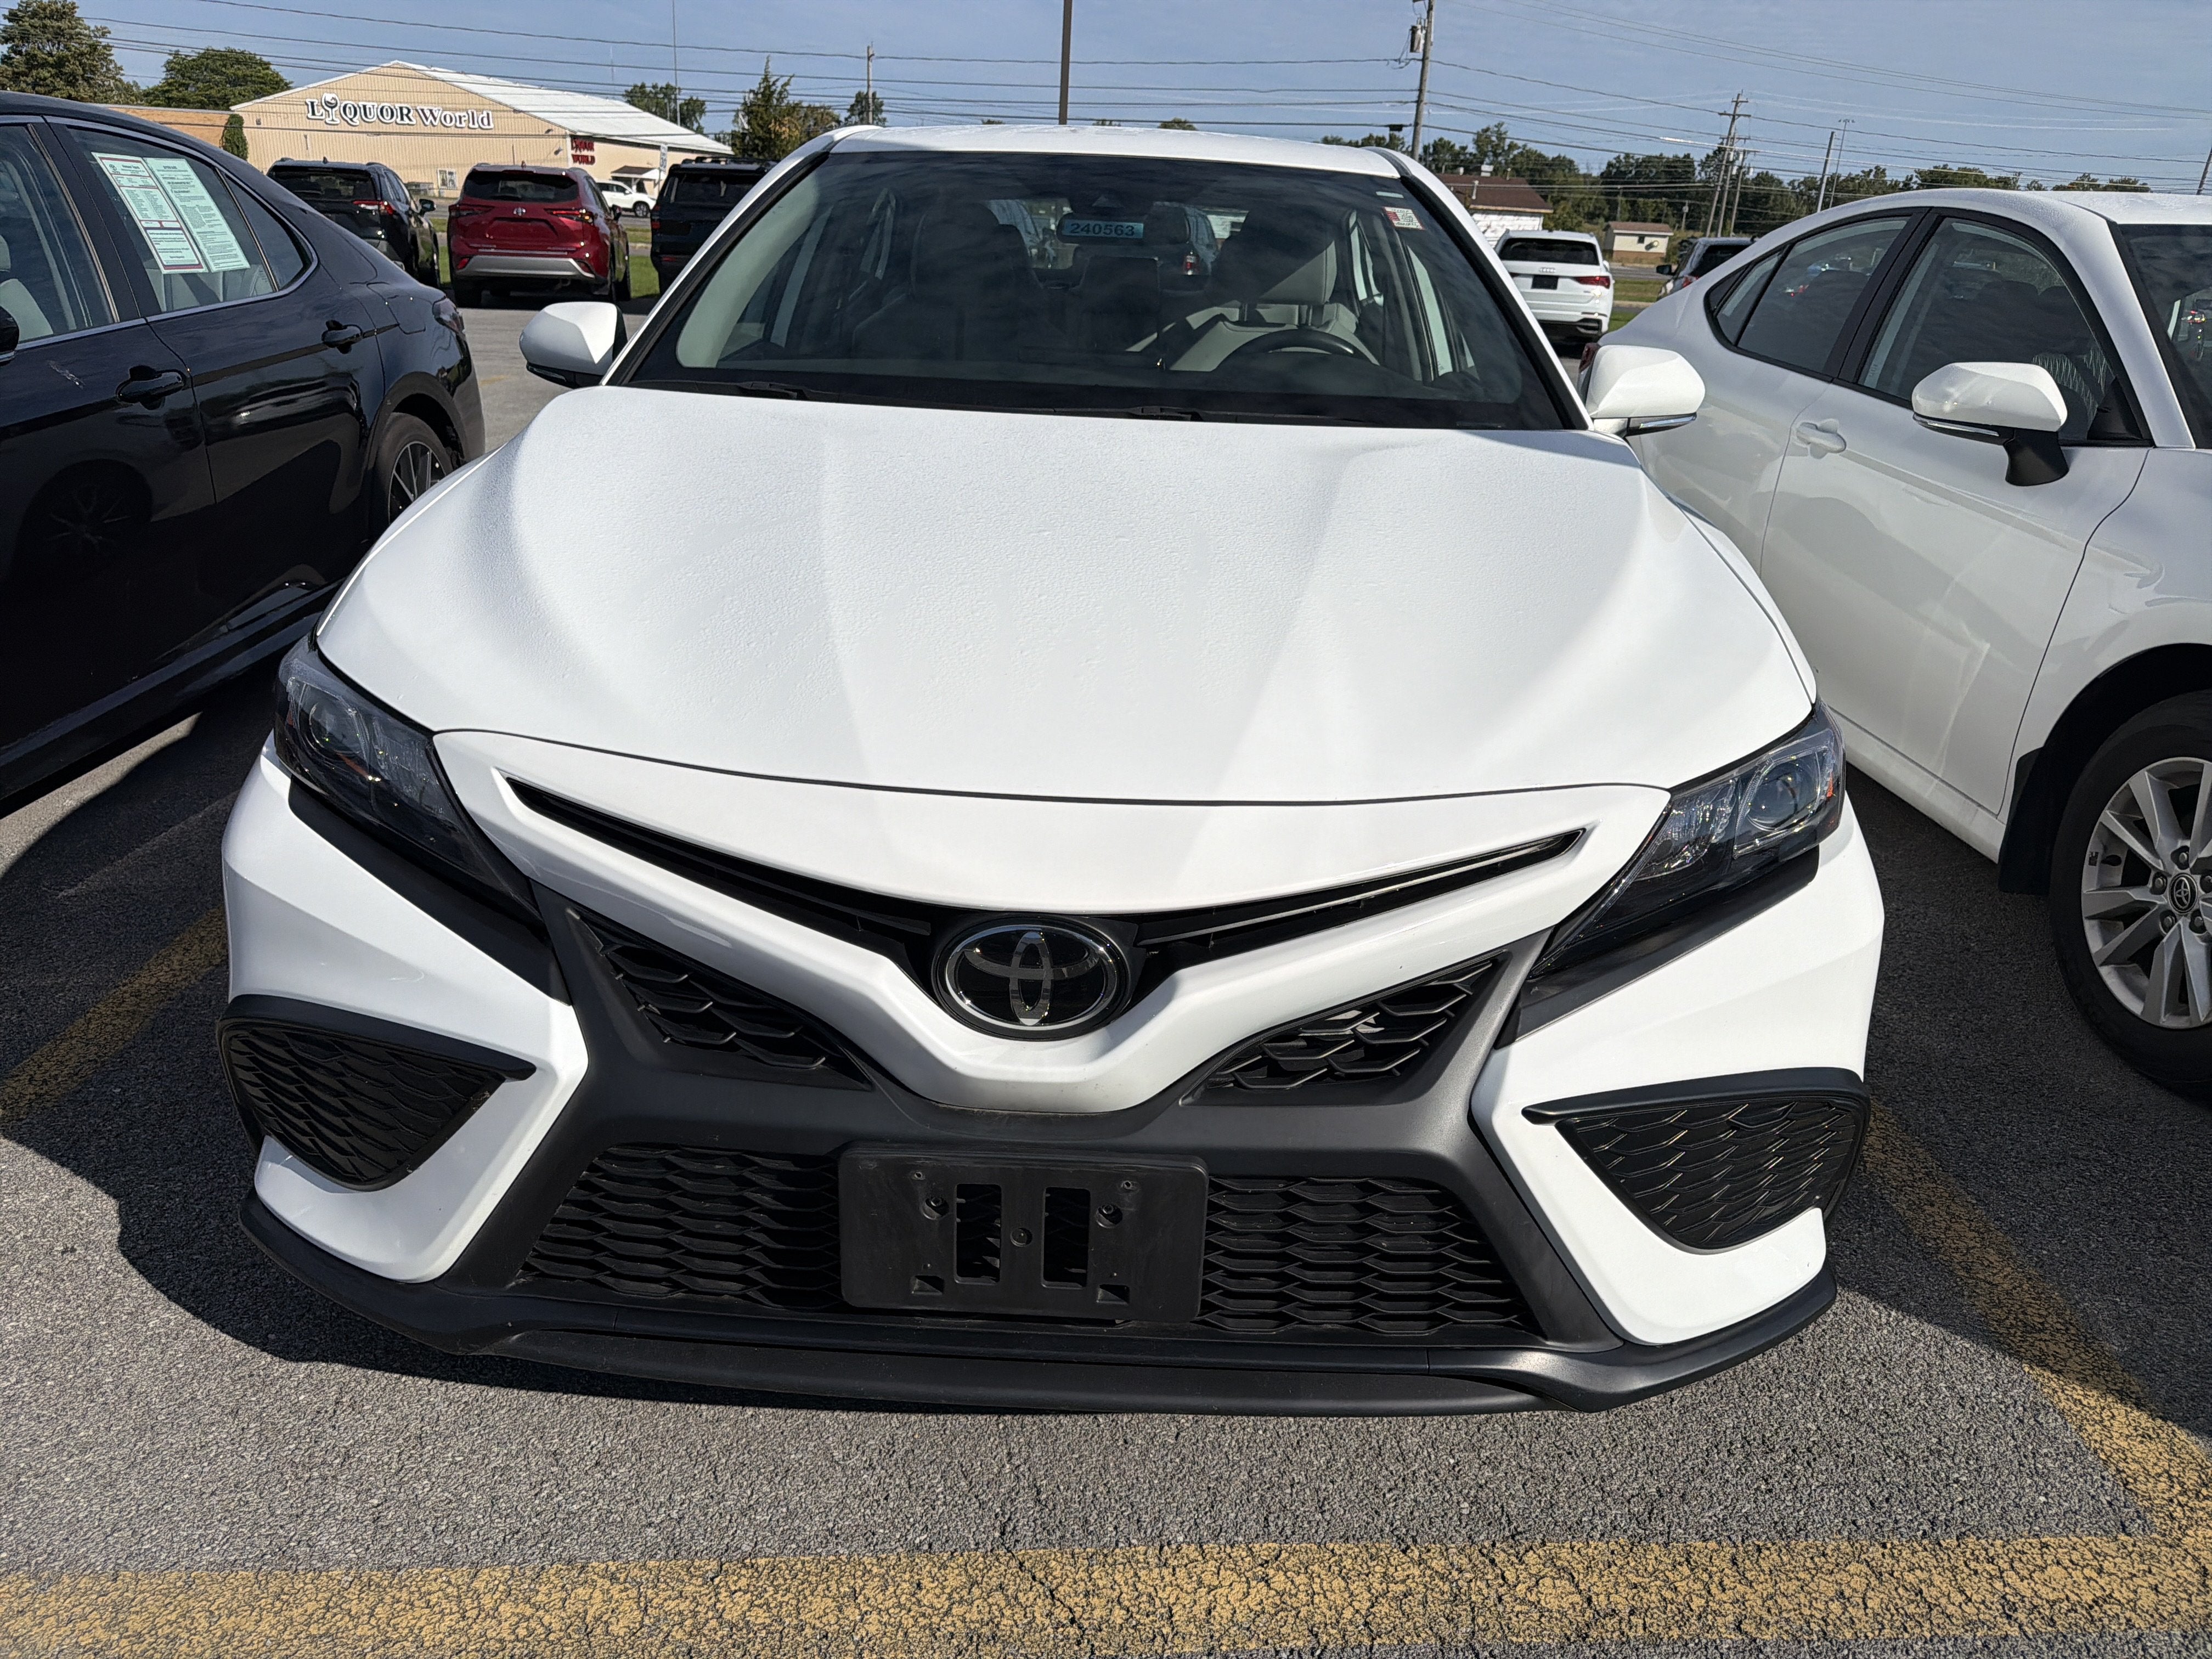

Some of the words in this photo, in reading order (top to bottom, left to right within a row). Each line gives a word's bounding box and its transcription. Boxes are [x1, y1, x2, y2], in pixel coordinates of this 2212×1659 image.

[306, 93, 416, 126] LIQUOR
[416, 106, 494, 129] World
[1070, 223, 1135, 236] 240563
